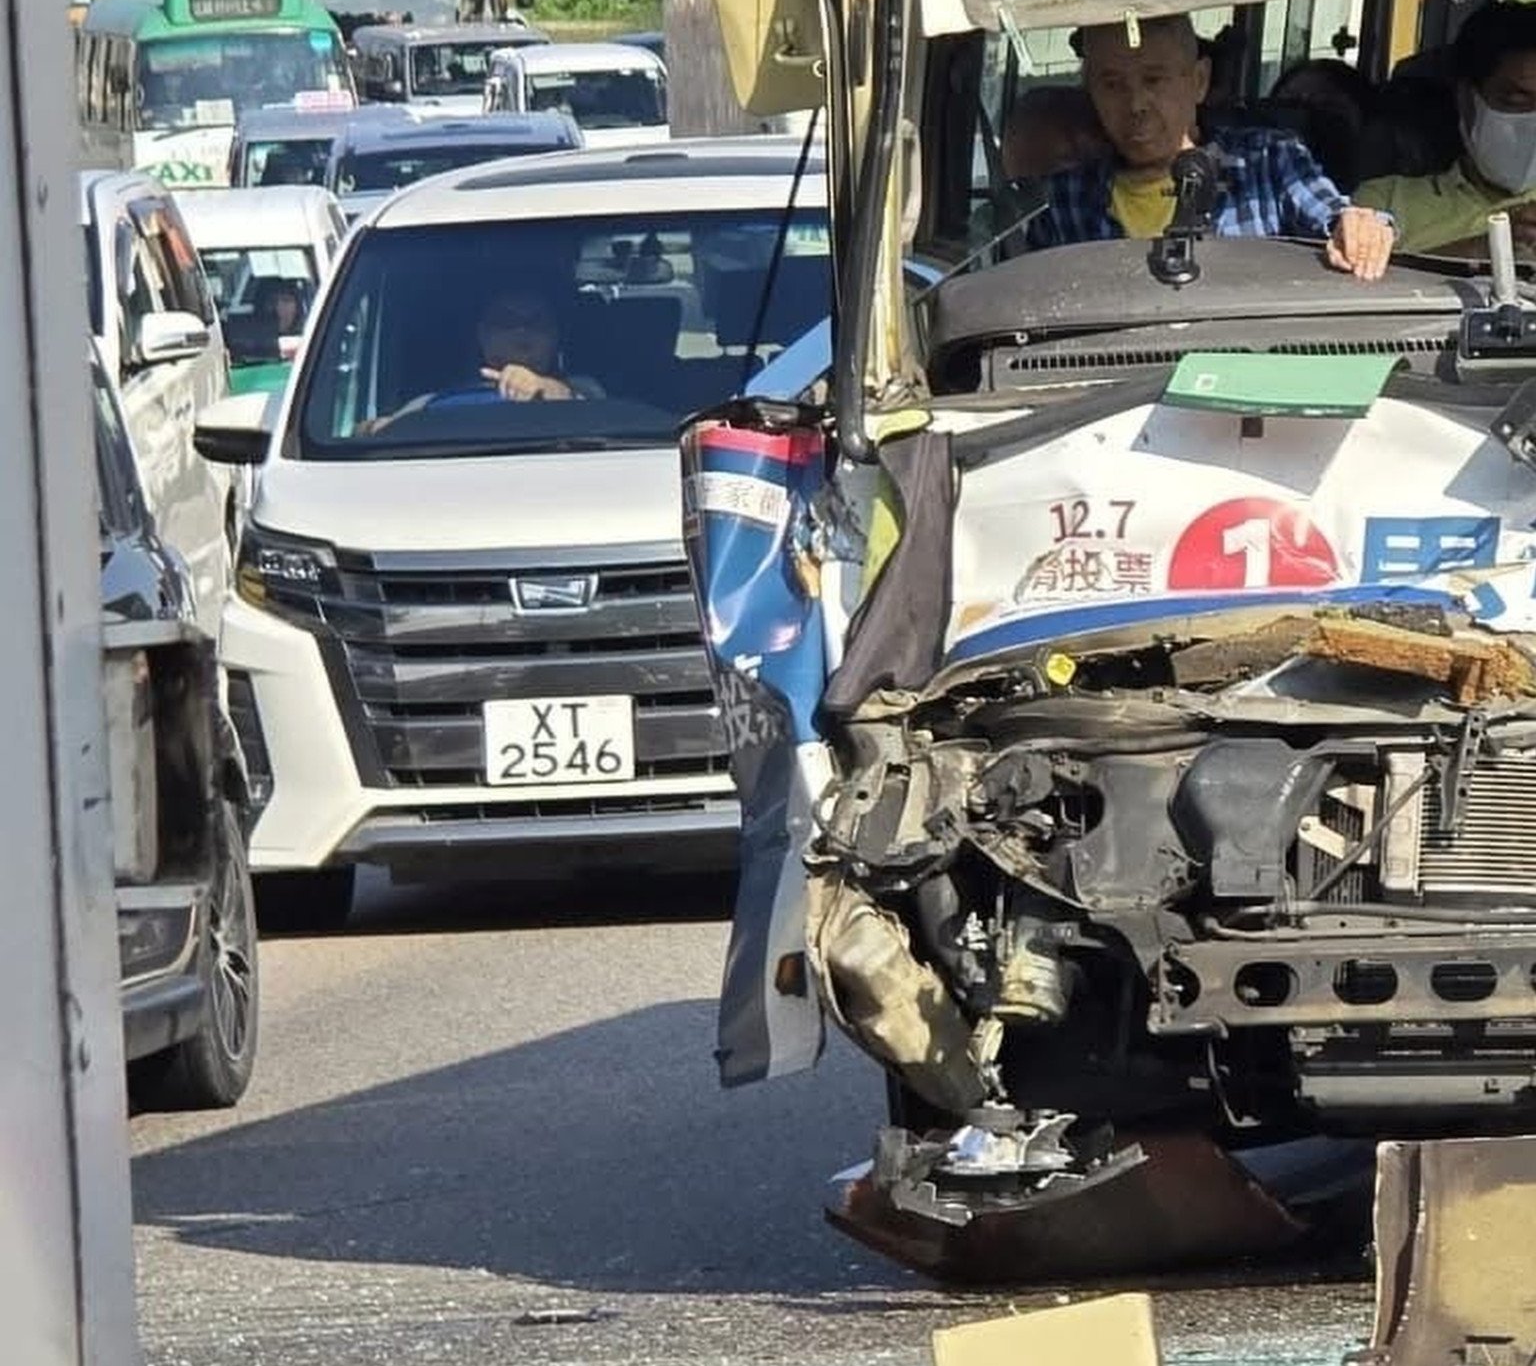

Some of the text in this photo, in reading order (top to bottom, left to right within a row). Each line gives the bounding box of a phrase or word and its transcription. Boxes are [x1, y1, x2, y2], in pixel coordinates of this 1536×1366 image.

[1049, 499, 1137, 543] 12.7
[531, 703, 589, 741] XT
[500, 739, 622, 779] 2546
